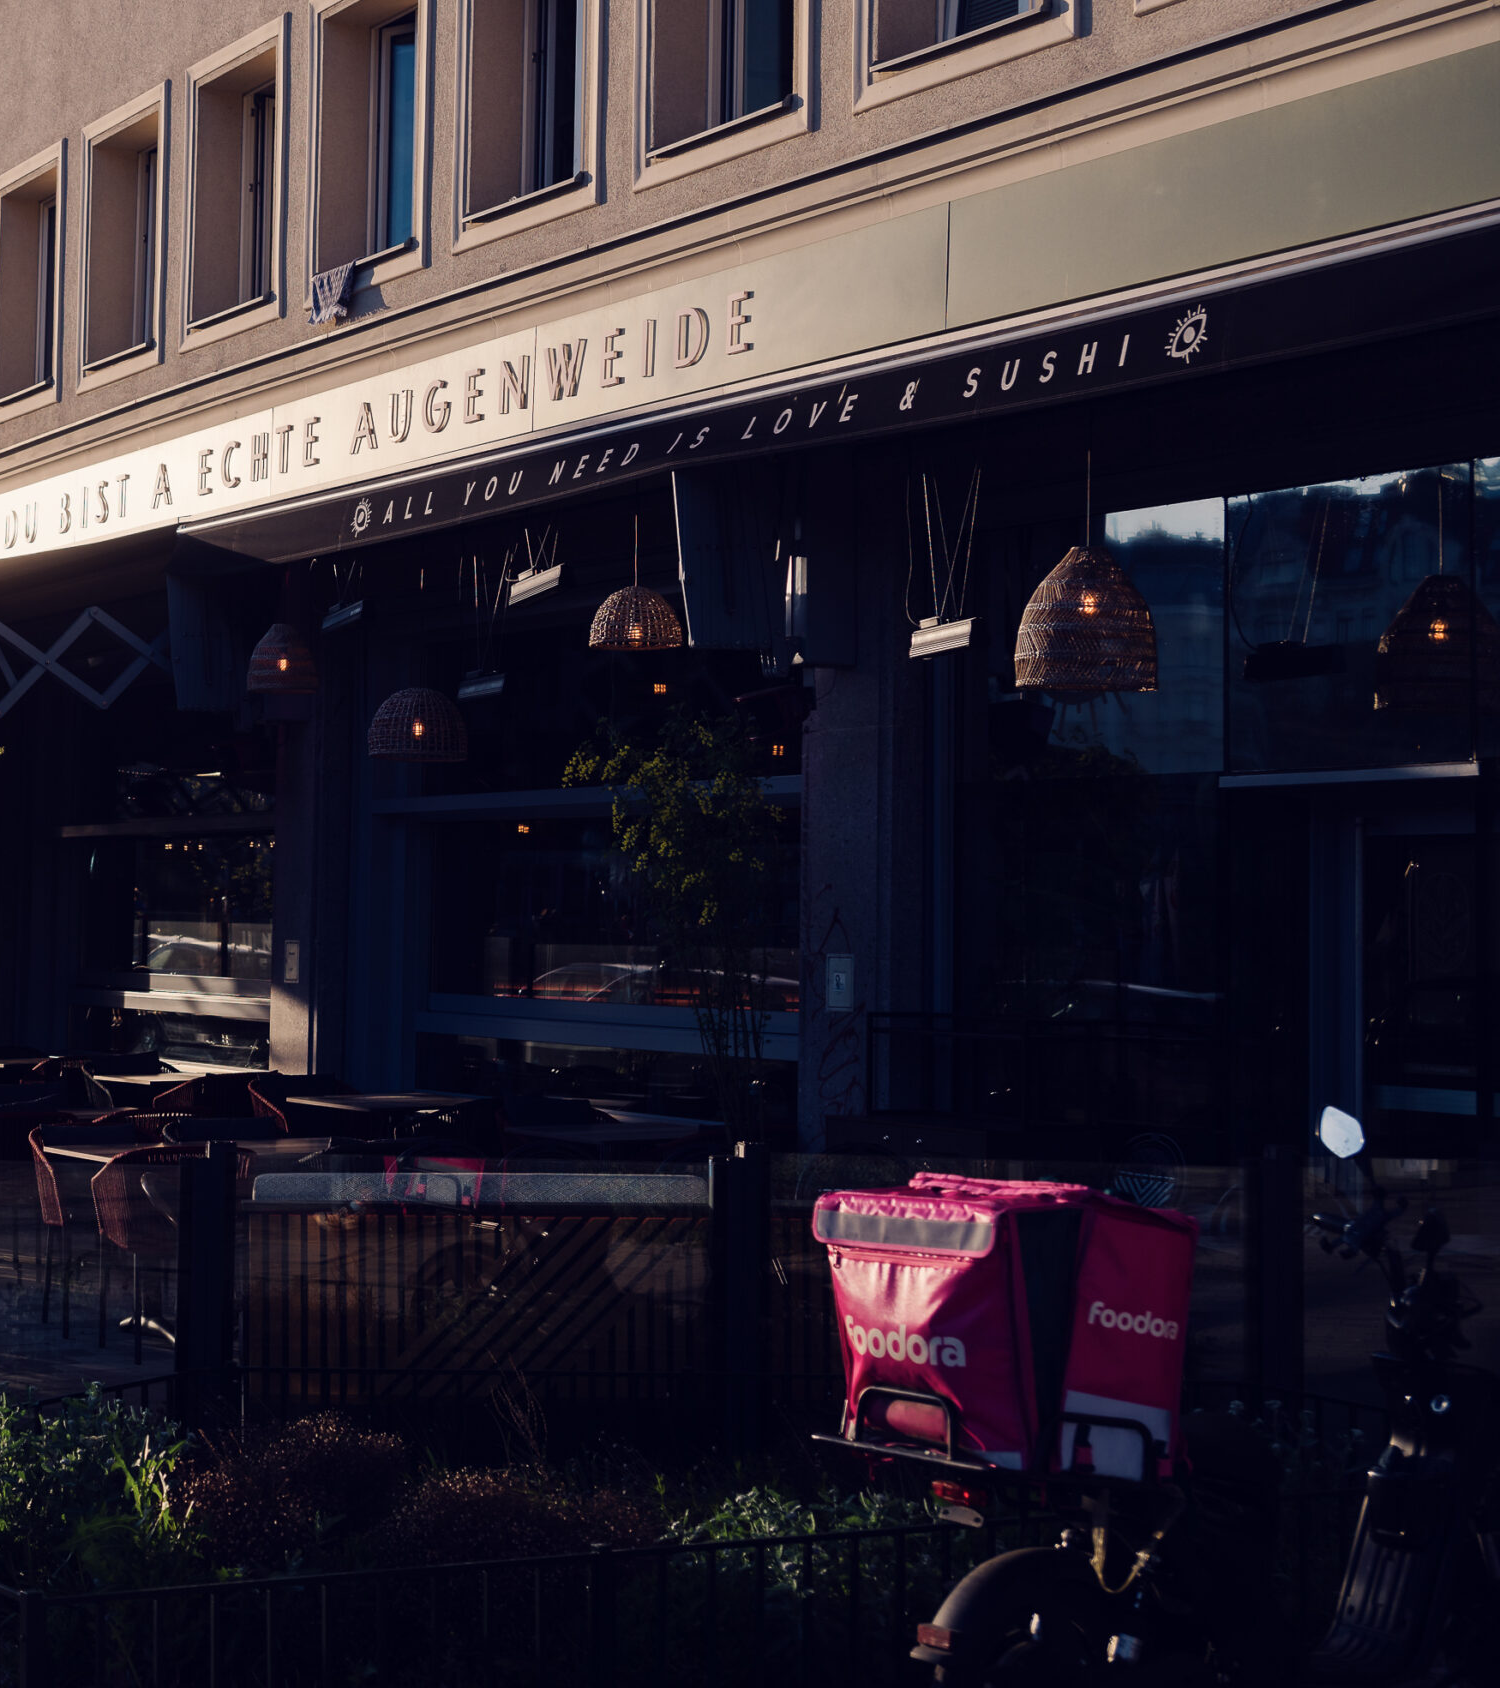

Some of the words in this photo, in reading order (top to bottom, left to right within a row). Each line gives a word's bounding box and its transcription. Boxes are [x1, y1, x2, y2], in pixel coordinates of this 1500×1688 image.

[3, 501, 38, 550] DU
[58, 473, 130, 534] BIST
[151, 463, 173, 509] A
[197, 416, 321, 496] ECHTE
[349, 290, 756, 455] AUGENWEIDE
[382, 491, 434, 526] ALL
[463, 470, 524, 506] YOU
[548, 442, 641, 486] NEED
[666, 426, 711, 455] IS
[740, 394, 859, 440] LOVE
[899, 380, 916, 411] &
[962, 333, 1131, 398] SUSHI
[845, 1314, 967, 1368] foodora
[1088, 1300, 1180, 1341] foodora
